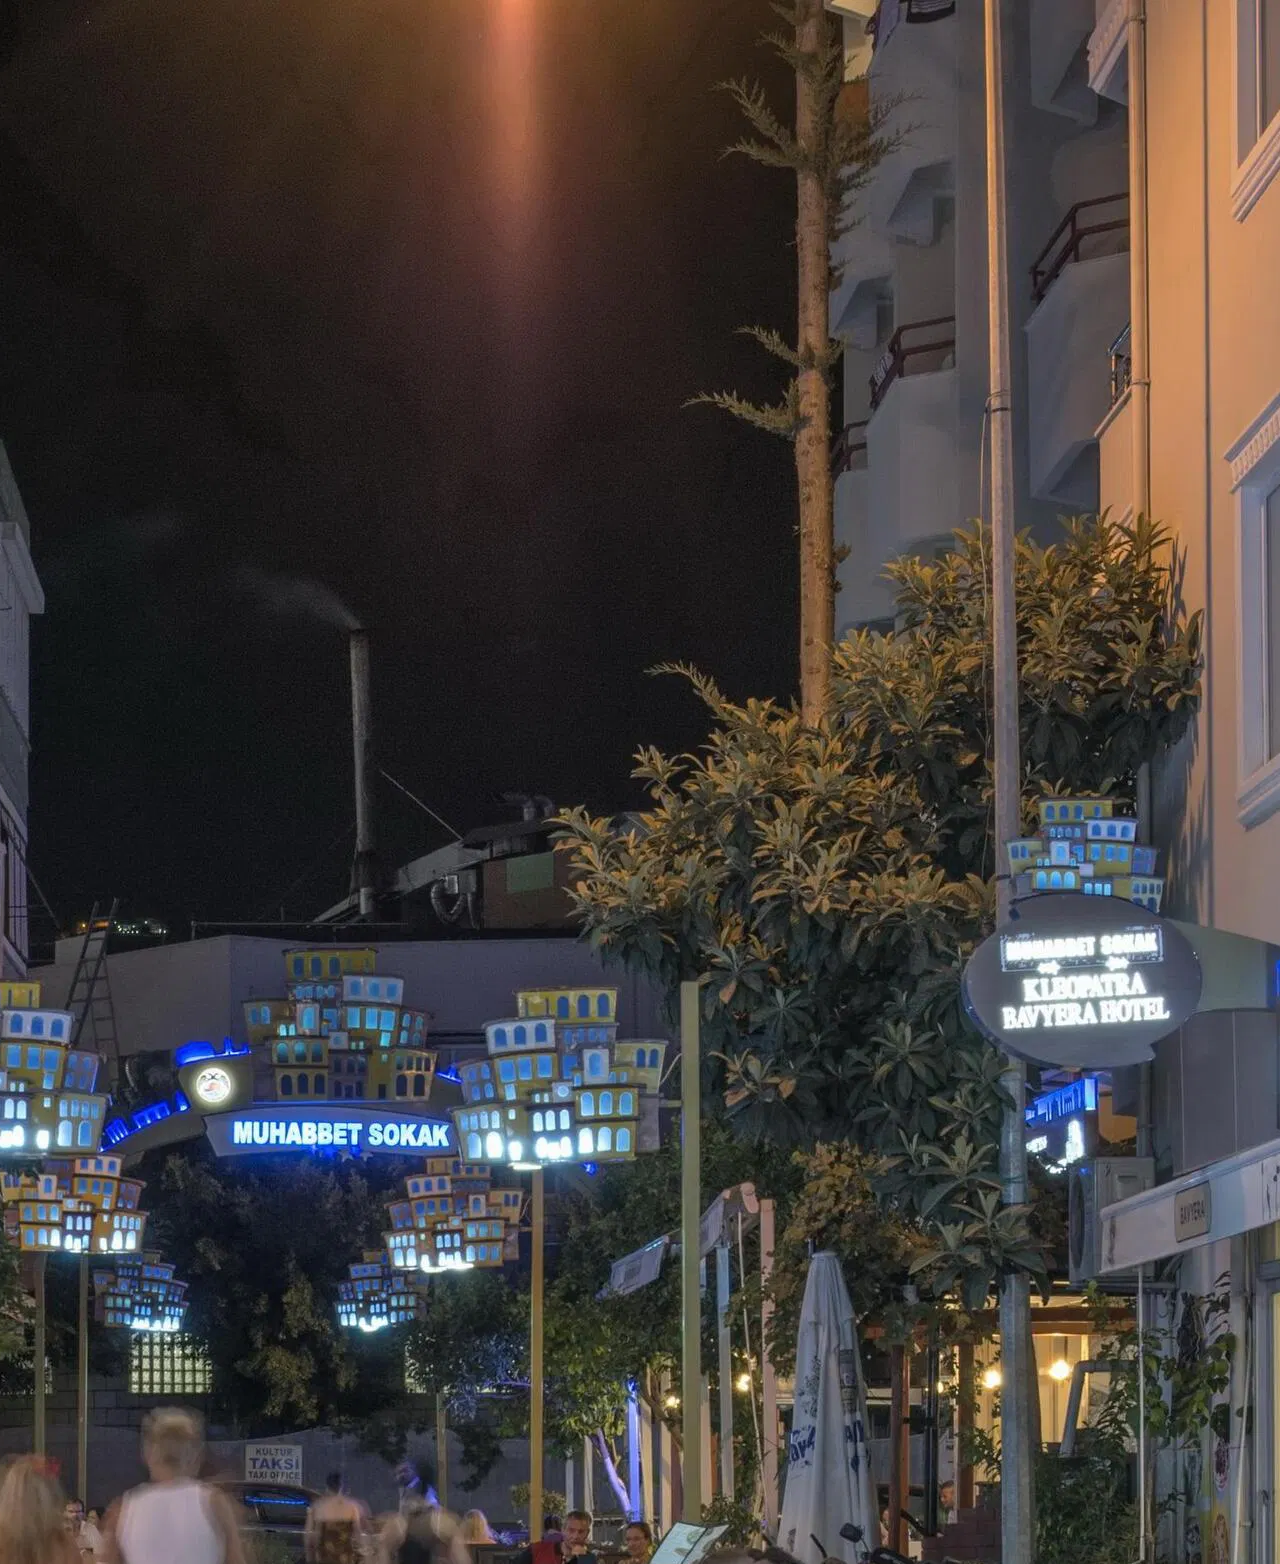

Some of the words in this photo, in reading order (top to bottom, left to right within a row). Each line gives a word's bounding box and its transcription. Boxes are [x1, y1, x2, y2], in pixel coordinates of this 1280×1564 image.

[1022, 972, 1147, 1002] KLEOPATRA
[1002, 1000, 1098, 1029] BAVYERA
[1100, 997, 1170, 1024] HOTEL
[233, 1121, 362, 1146] MUHABBET
[368, 1123, 449, 1147] SOKAK
[248, 1471, 268, 1479] TAXI
[270, 1471, 300, 1480] OFFICE
